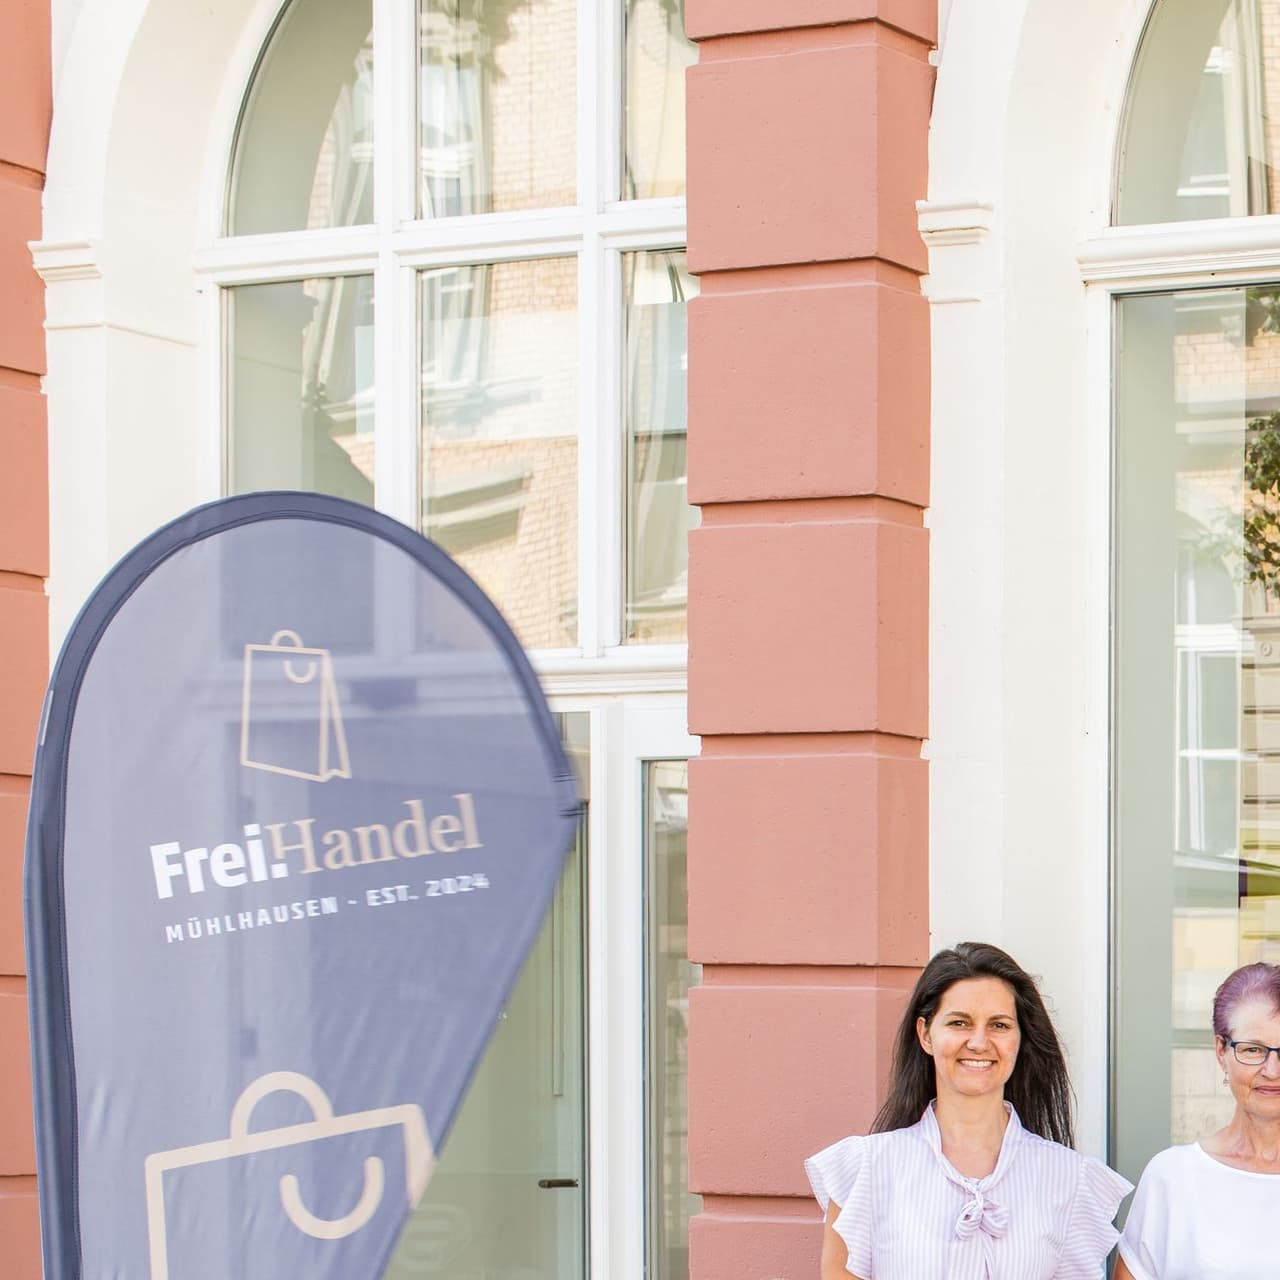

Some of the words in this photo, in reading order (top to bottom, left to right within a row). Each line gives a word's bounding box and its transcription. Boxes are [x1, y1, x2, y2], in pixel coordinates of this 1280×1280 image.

[165, 896, 338, 943] MÜHLHAUSEN
[366, 884, 420, 906] EST.
[425, 873, 490, 897] 2024
